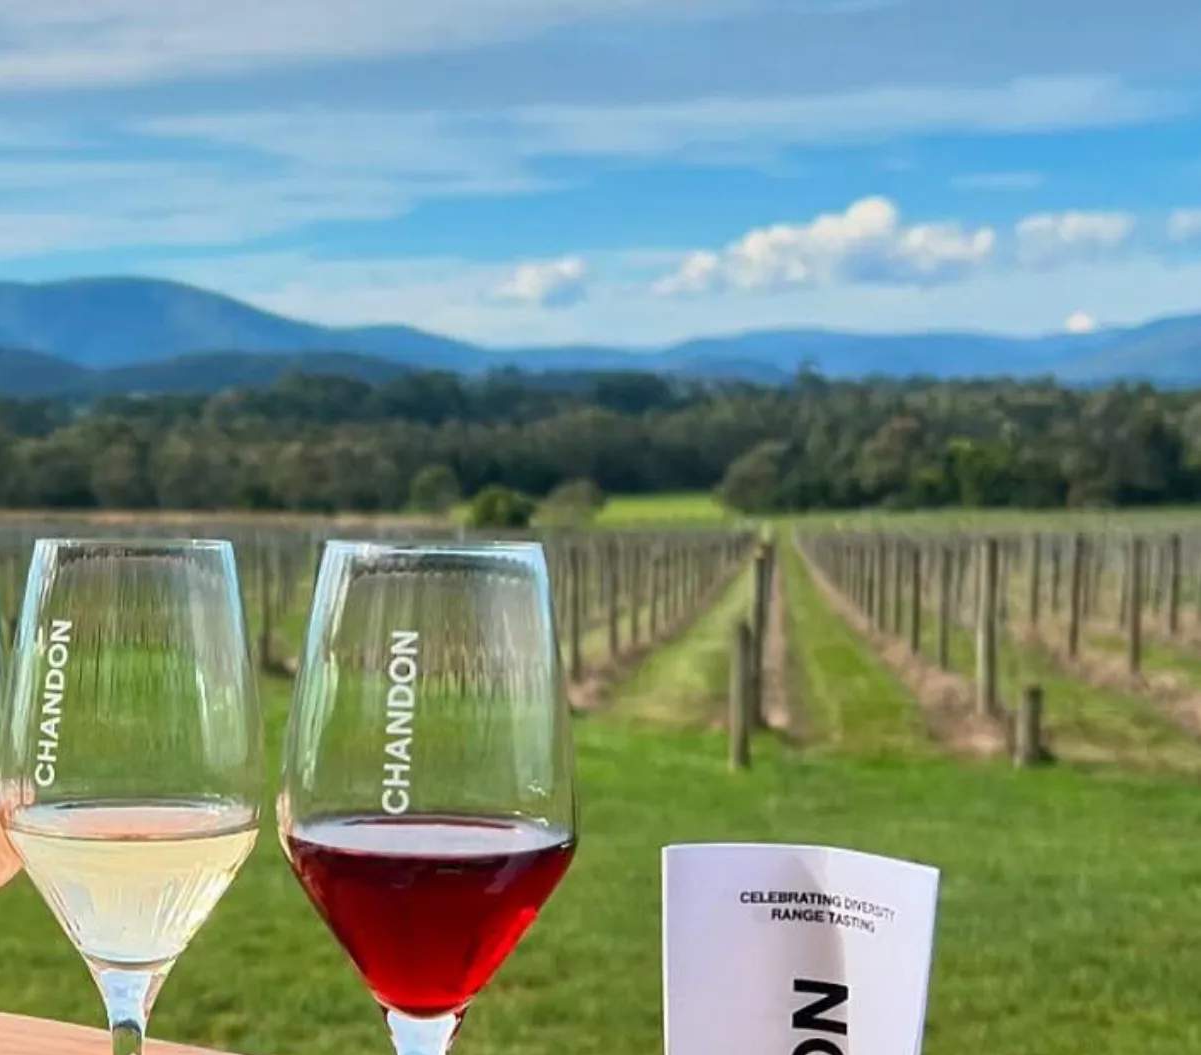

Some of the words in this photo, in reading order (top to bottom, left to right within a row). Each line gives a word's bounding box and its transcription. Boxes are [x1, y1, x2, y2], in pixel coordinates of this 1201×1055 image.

[35, 619, 73, 787] CHANDON
[382, 630, 419, 815] CHANDON
[740, 891, 842, 908] CELEBRATING
[844, 897, 895, 922] DIVERSITY
[771, 908, 825, 922] RANGE
[828, 911, 875, 933] TASTING
